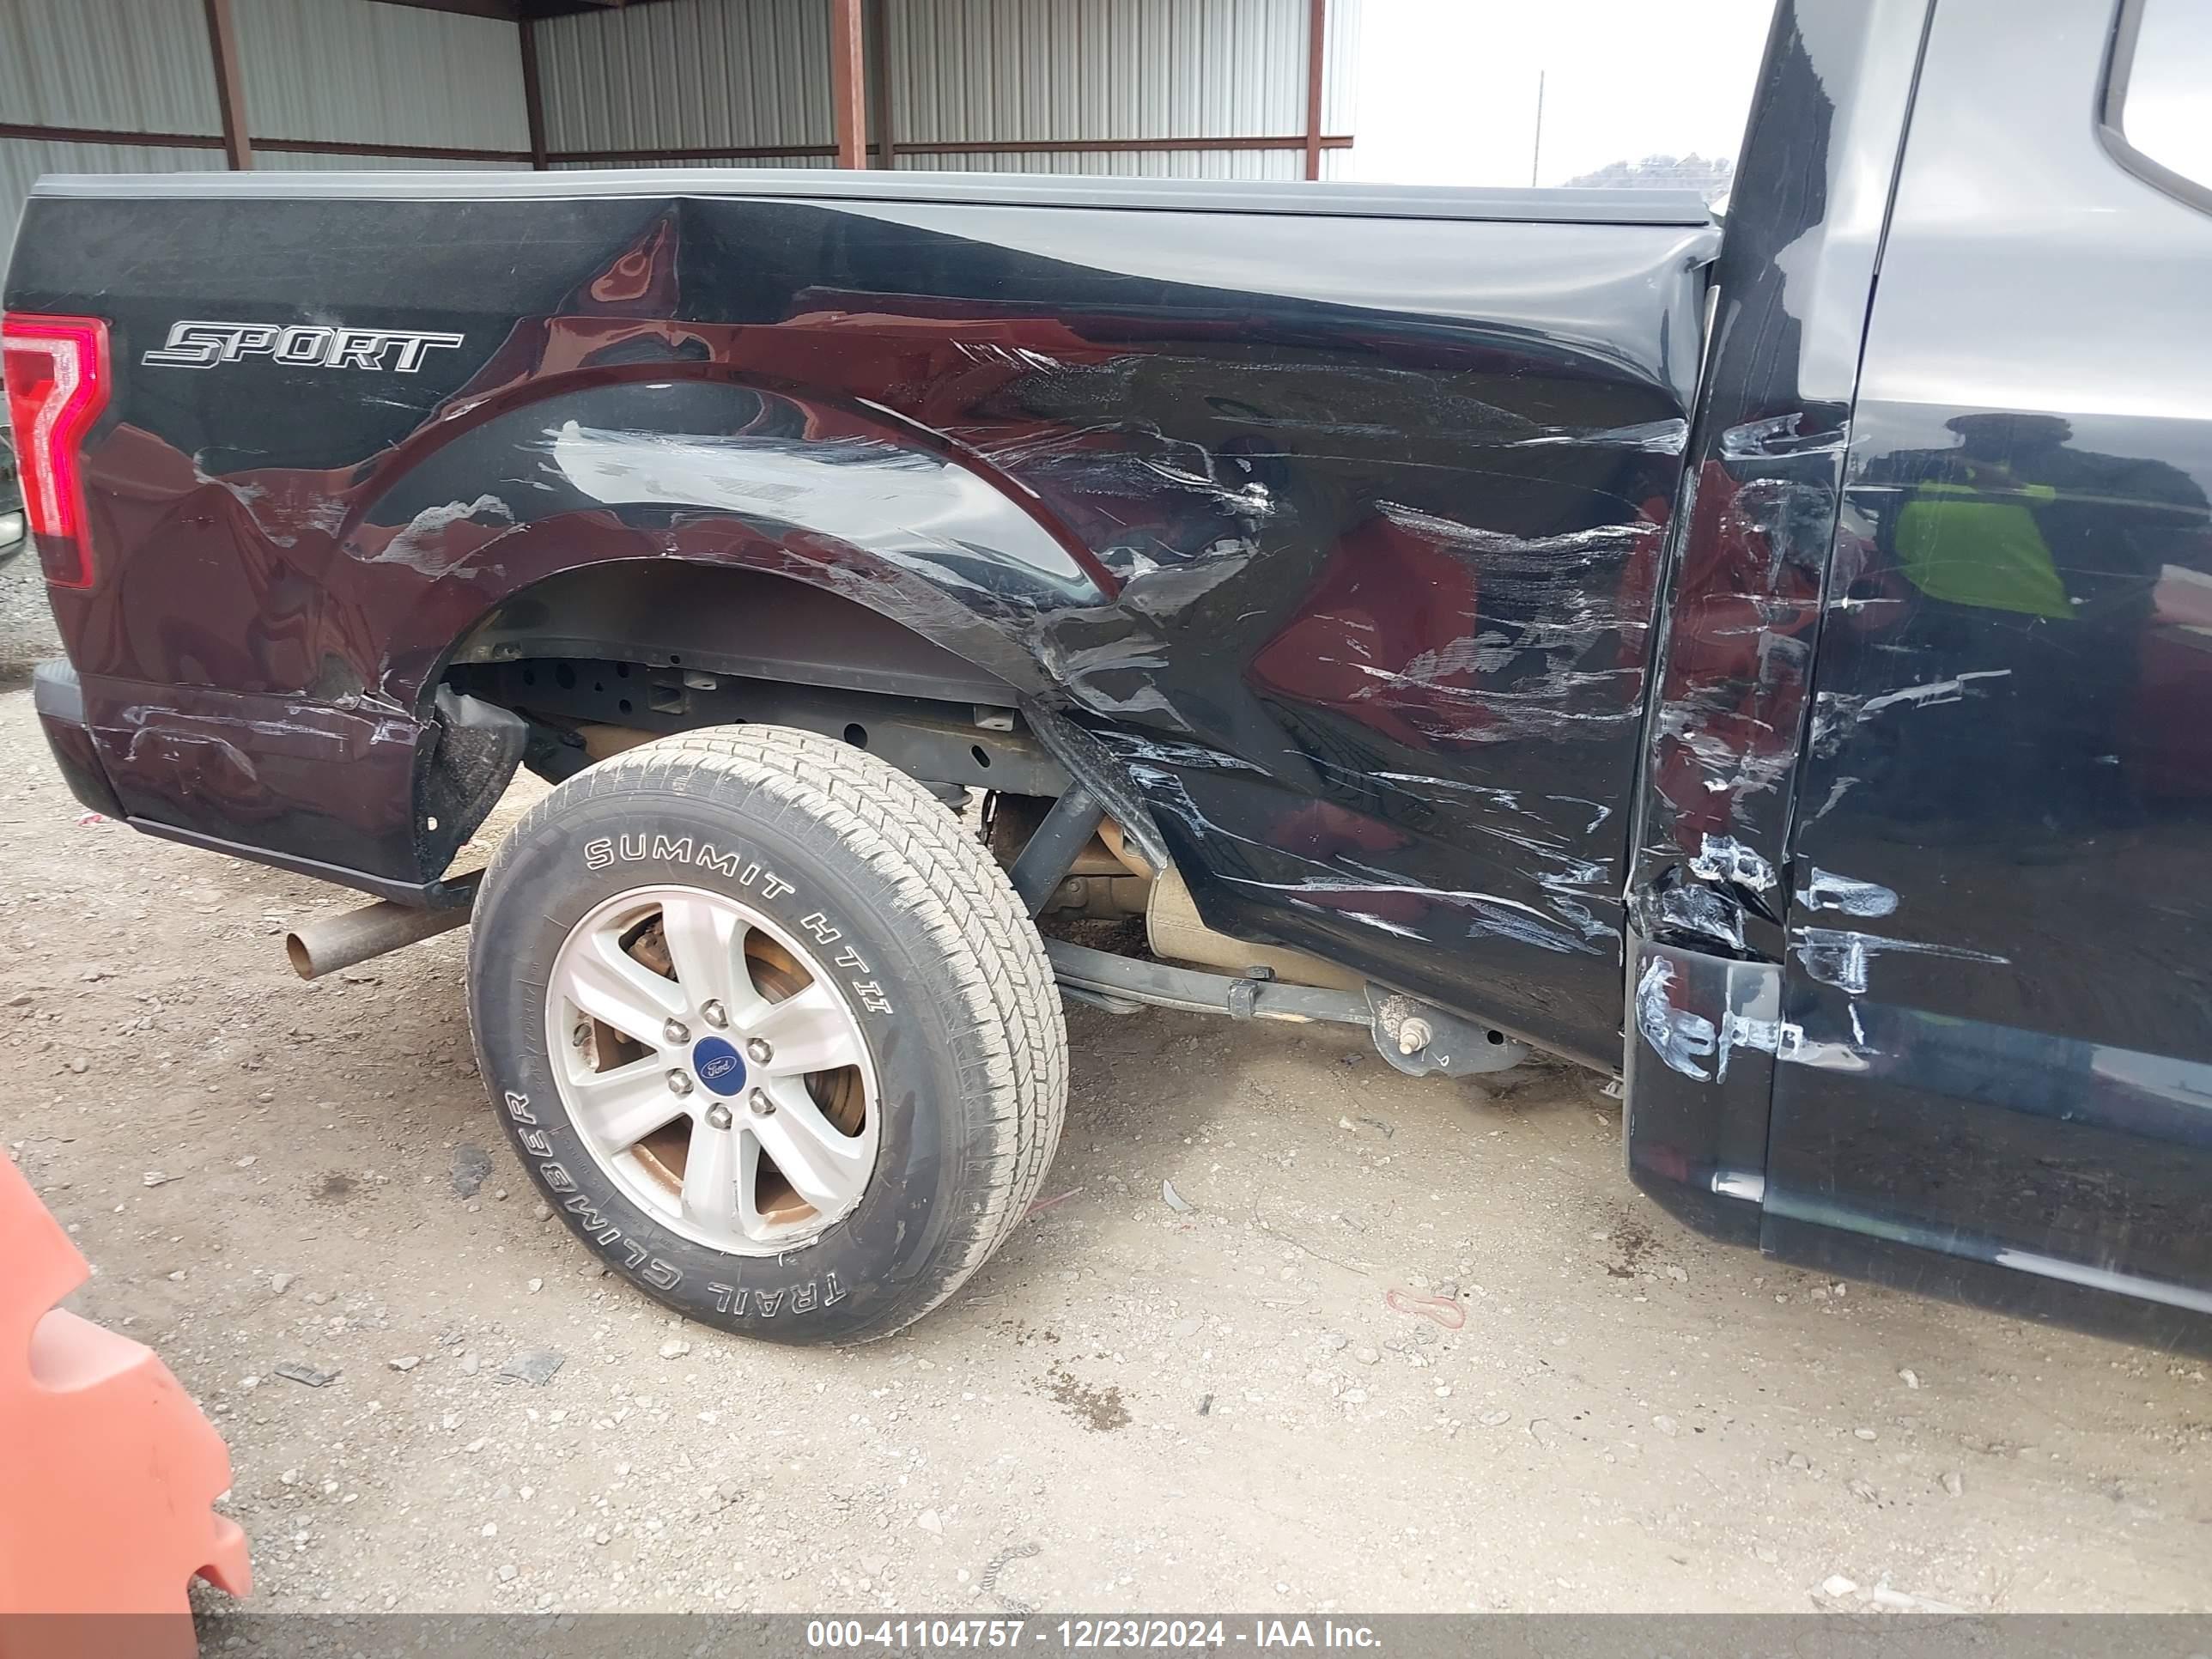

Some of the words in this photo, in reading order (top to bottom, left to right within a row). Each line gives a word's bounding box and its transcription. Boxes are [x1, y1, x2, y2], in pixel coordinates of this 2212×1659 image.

[141, 320, 465, 372] SPORT
[584, 833, 796, 900] SUMMIT
[706, 1059, 731, 1077] Ford
[505, 1091, 684, 1291] CLIMBER
[708, 1272, 848, 1317] TRAIL
